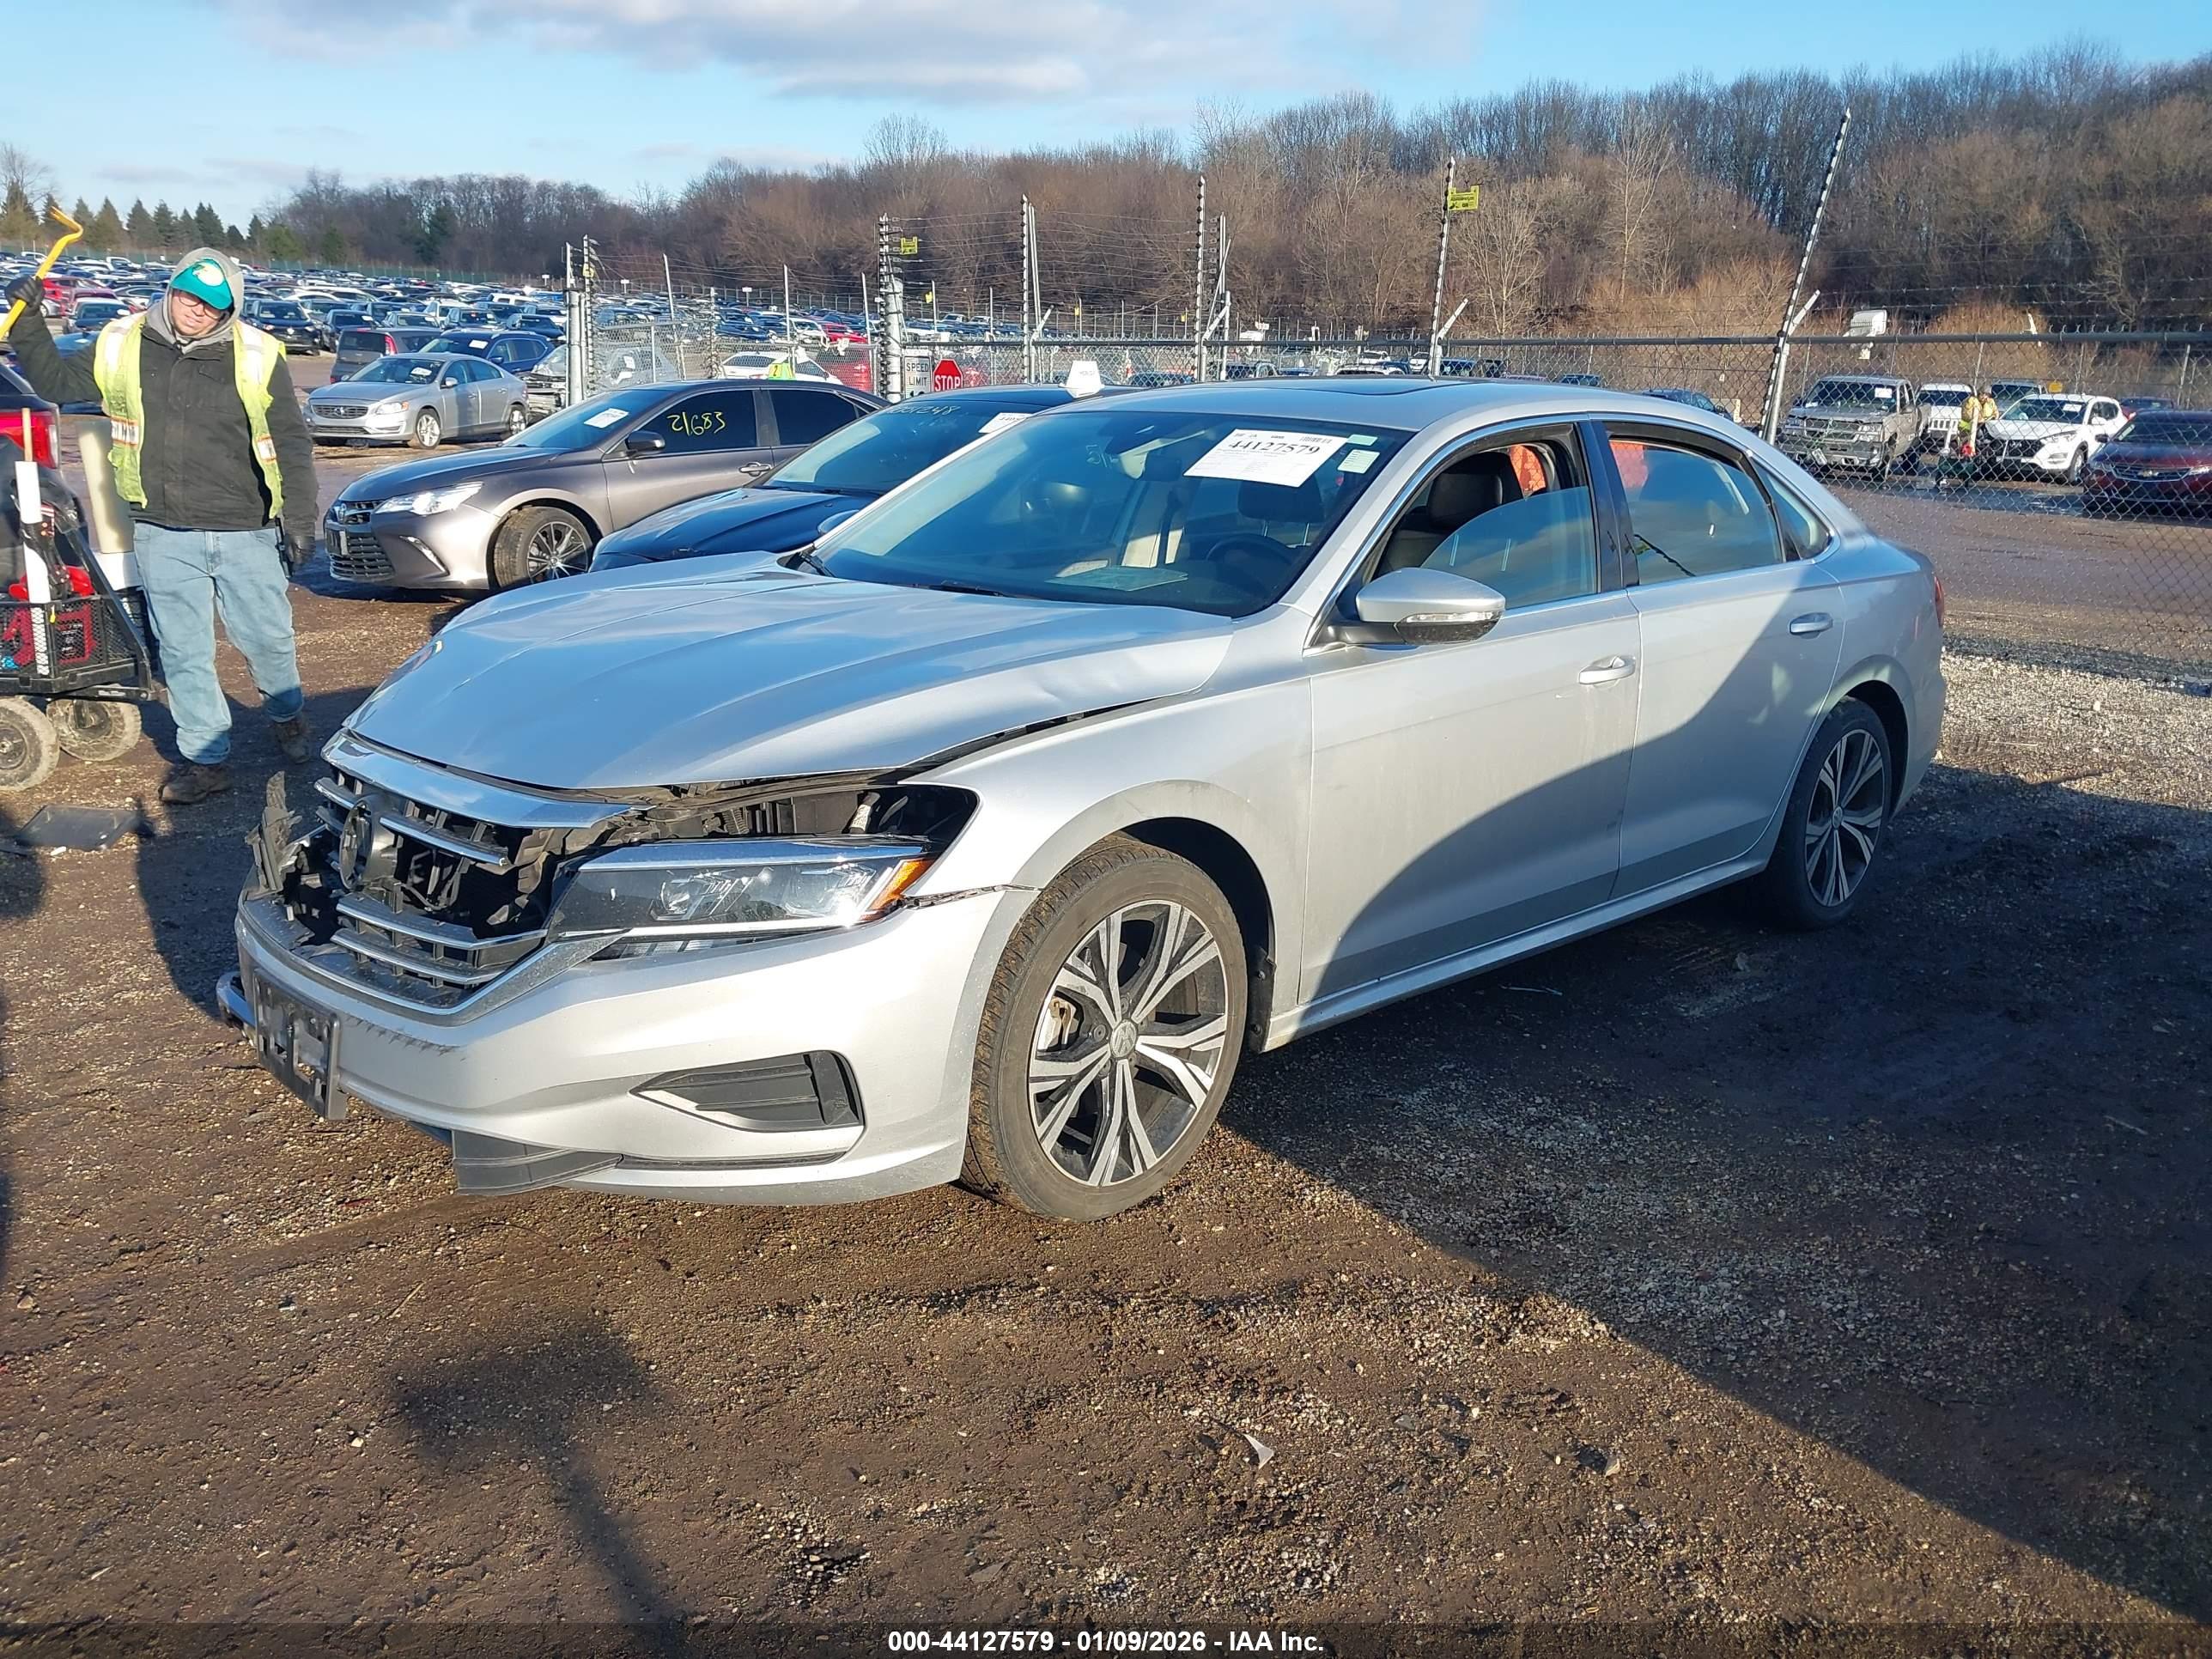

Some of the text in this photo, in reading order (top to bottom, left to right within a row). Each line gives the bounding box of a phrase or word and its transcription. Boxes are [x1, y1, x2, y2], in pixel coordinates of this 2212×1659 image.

[773, 364, 778, 376] 2
[906, 362, 929, 373] SPEED
[908, 376, 927, 386] LIMIT
[934, 374, 961, 392] STOP
[666, 411, 726, 436] 21683
[1229, 440, 1321, 455] 44127579
